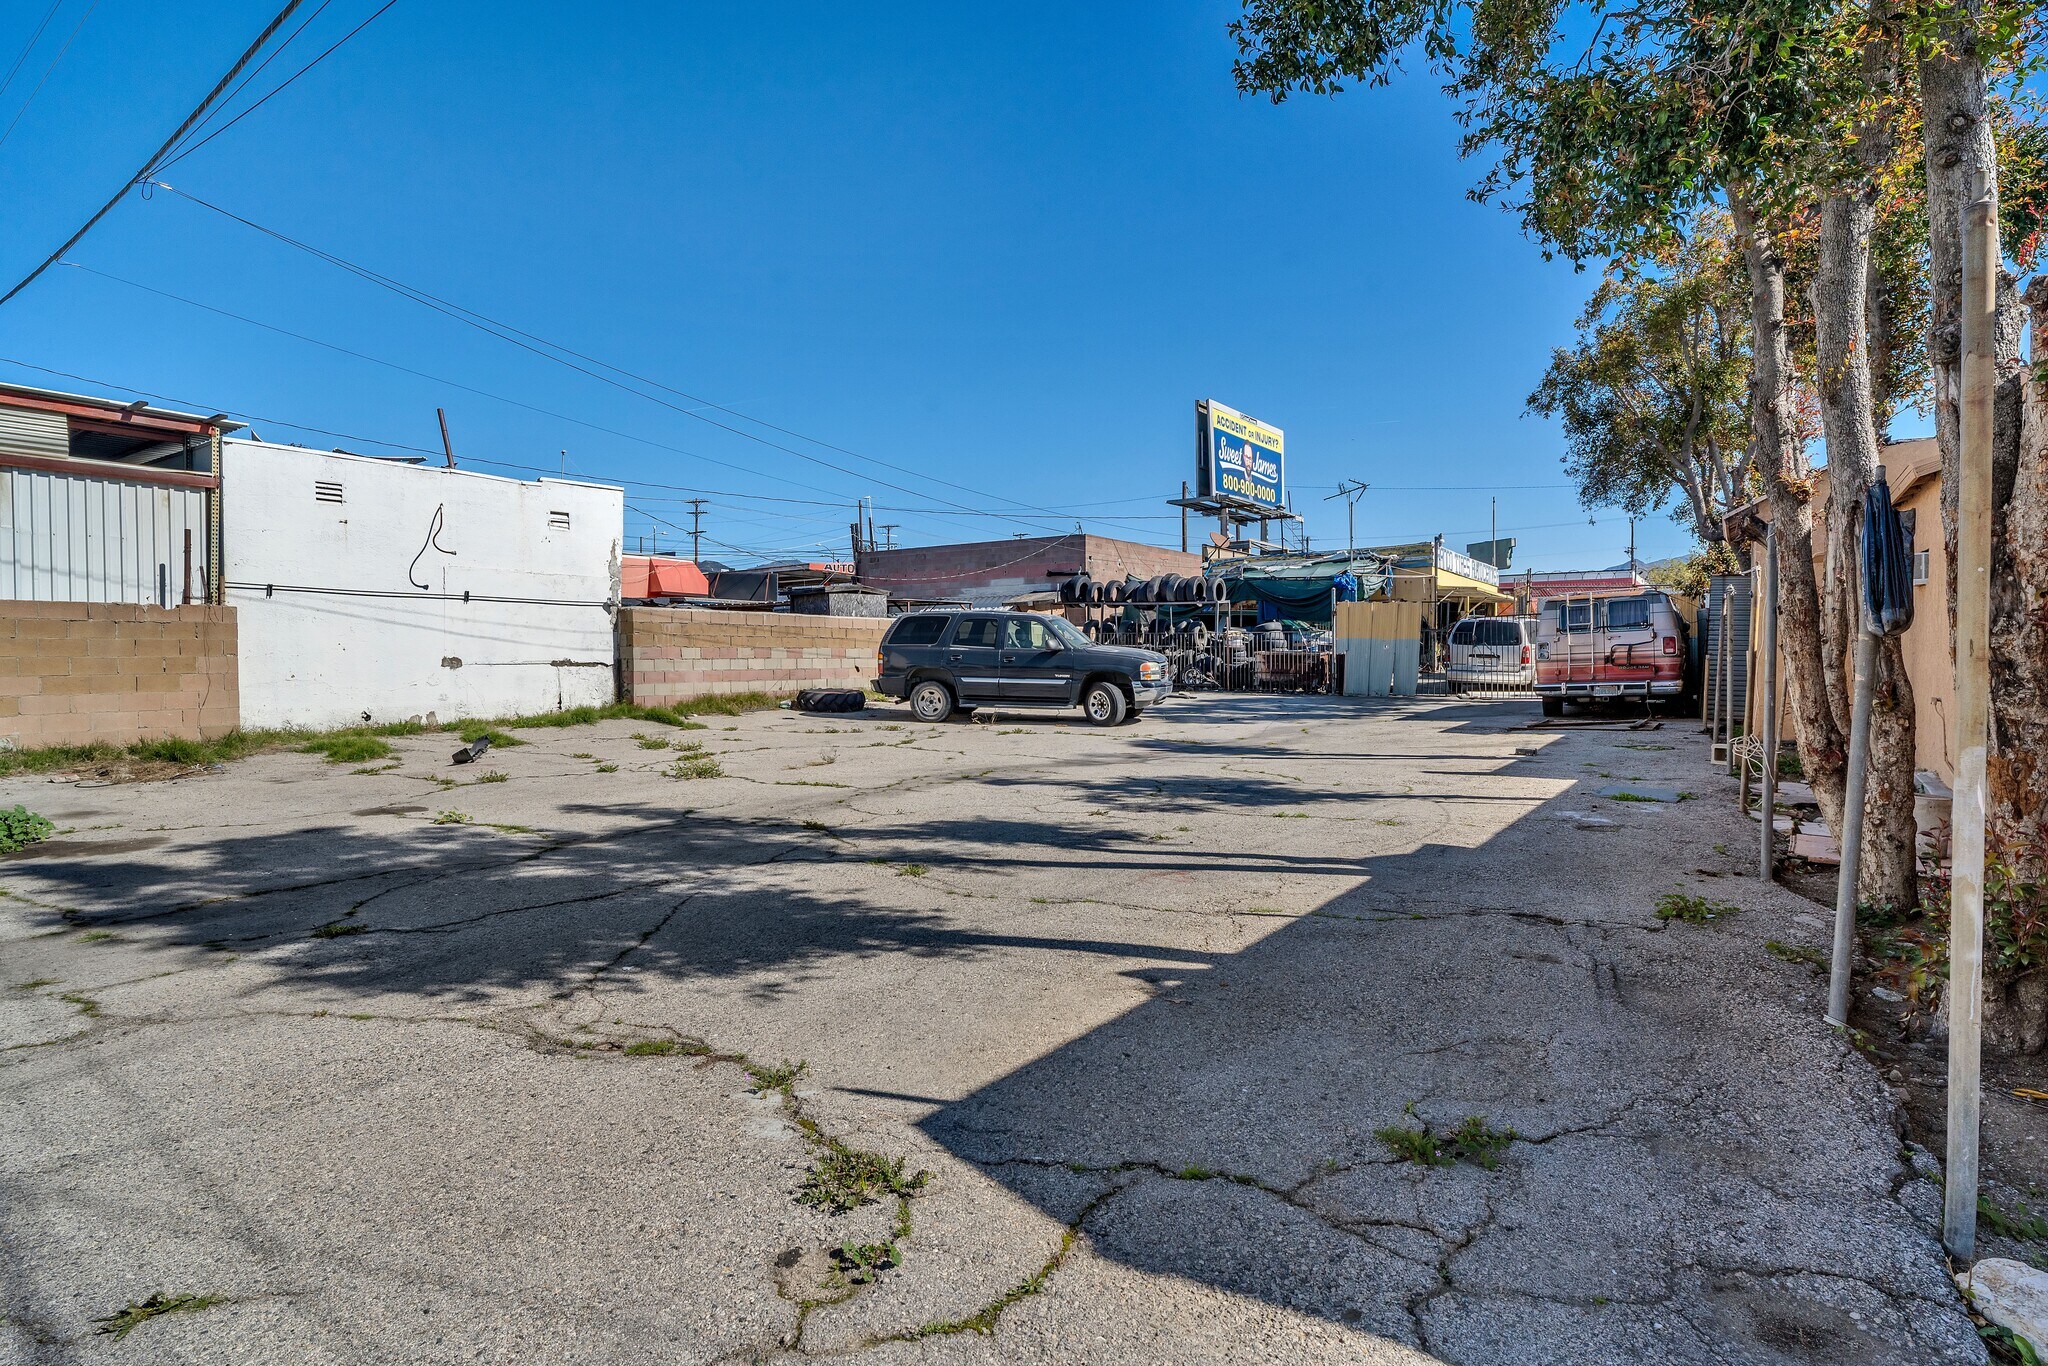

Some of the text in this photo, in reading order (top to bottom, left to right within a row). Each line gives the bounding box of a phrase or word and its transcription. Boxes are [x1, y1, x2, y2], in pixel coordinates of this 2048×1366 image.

[1216, 415, 1247, 436] ACCIDENT
[1255, 431, 1279, 449] INJURY?
[1219, 437, 1278, 477] Sweet James
[1223, 473, 1276, 503] 800-900-0000
[824, 564, 855, 574] AUTO
